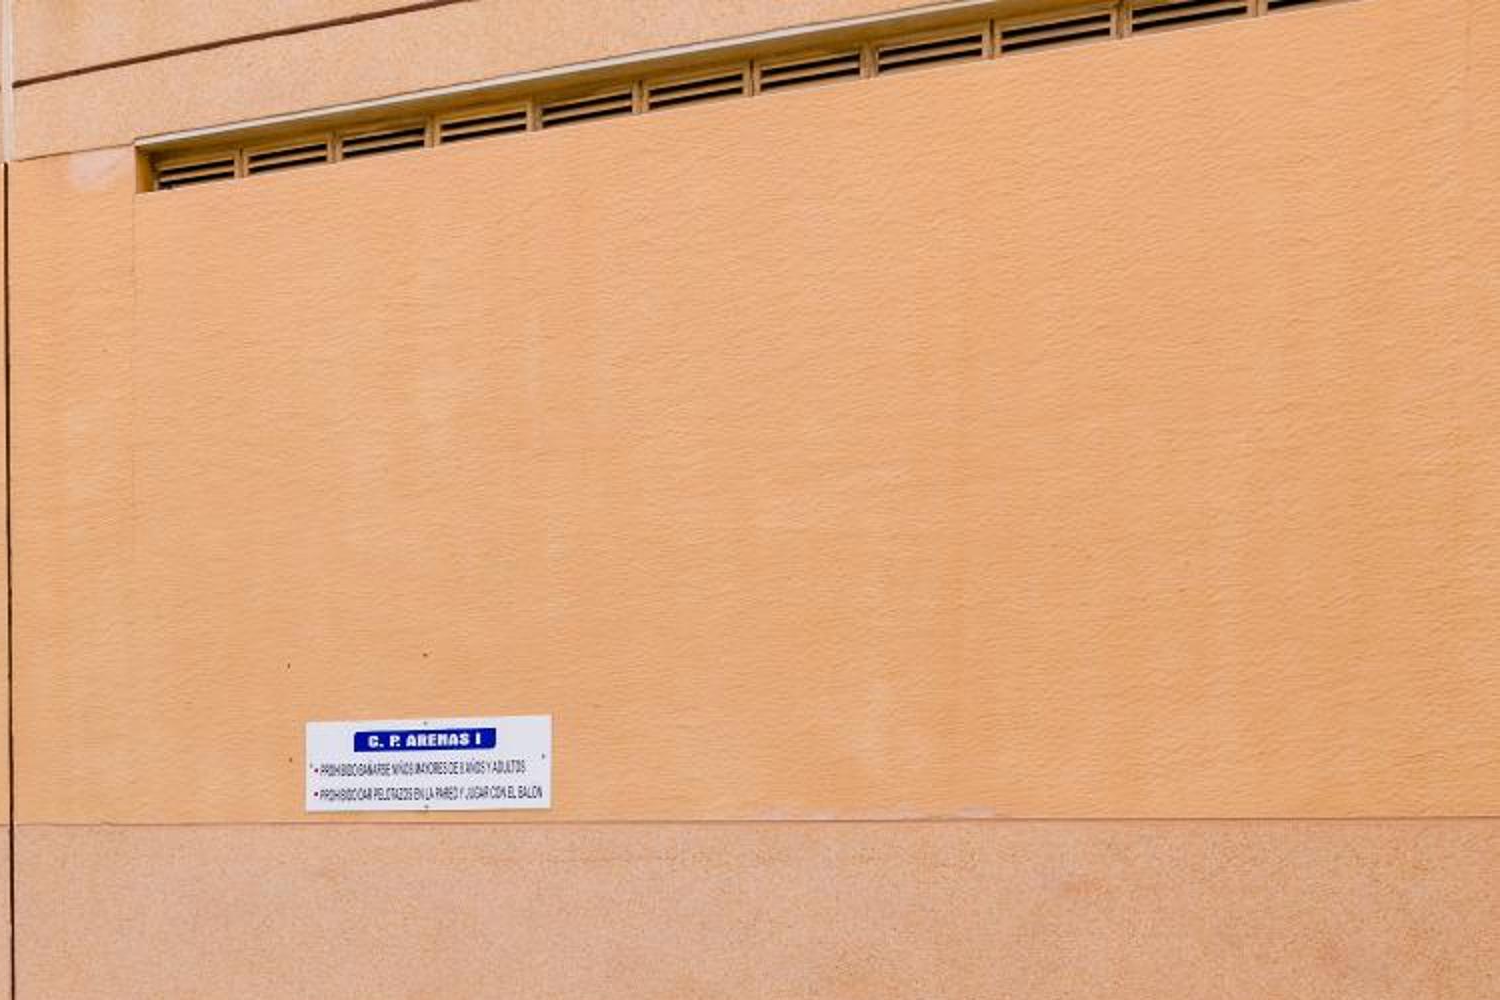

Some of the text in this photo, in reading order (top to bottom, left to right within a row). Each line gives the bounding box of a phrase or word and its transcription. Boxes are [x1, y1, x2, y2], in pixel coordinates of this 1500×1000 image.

[367, 732, 481, 748] C. P. ARENAS I
[320, 763, 356, 776] PROHIBIDO
[356, 762, 390, 776] BAÑARSE
[391, 760, 413, 775] NIÑOS
[413, 761, 446, 775] MAYORES
[449, 761, 458, 774] DE
[466, 758, 484, 774] AÑOS
[486, 761, 491, 774] Y
[492, 759, 525, 774] ADULTOS
[320, 788, 356, 801] PROHIBIDO
[358, 787, 372, 800] DAR
[373, 787, 412, 800] PELOTAZOS
[414, 787, 424, 800] EN
[425, 786, 434, 800] LA
[435, 786, 458, 800] PARED
[459, 785, 464, 800] Y
[465, 785, 489, 800] JUGAR
[490, 784, 507, 799] CON
[508, 784, 517, 799] EL
